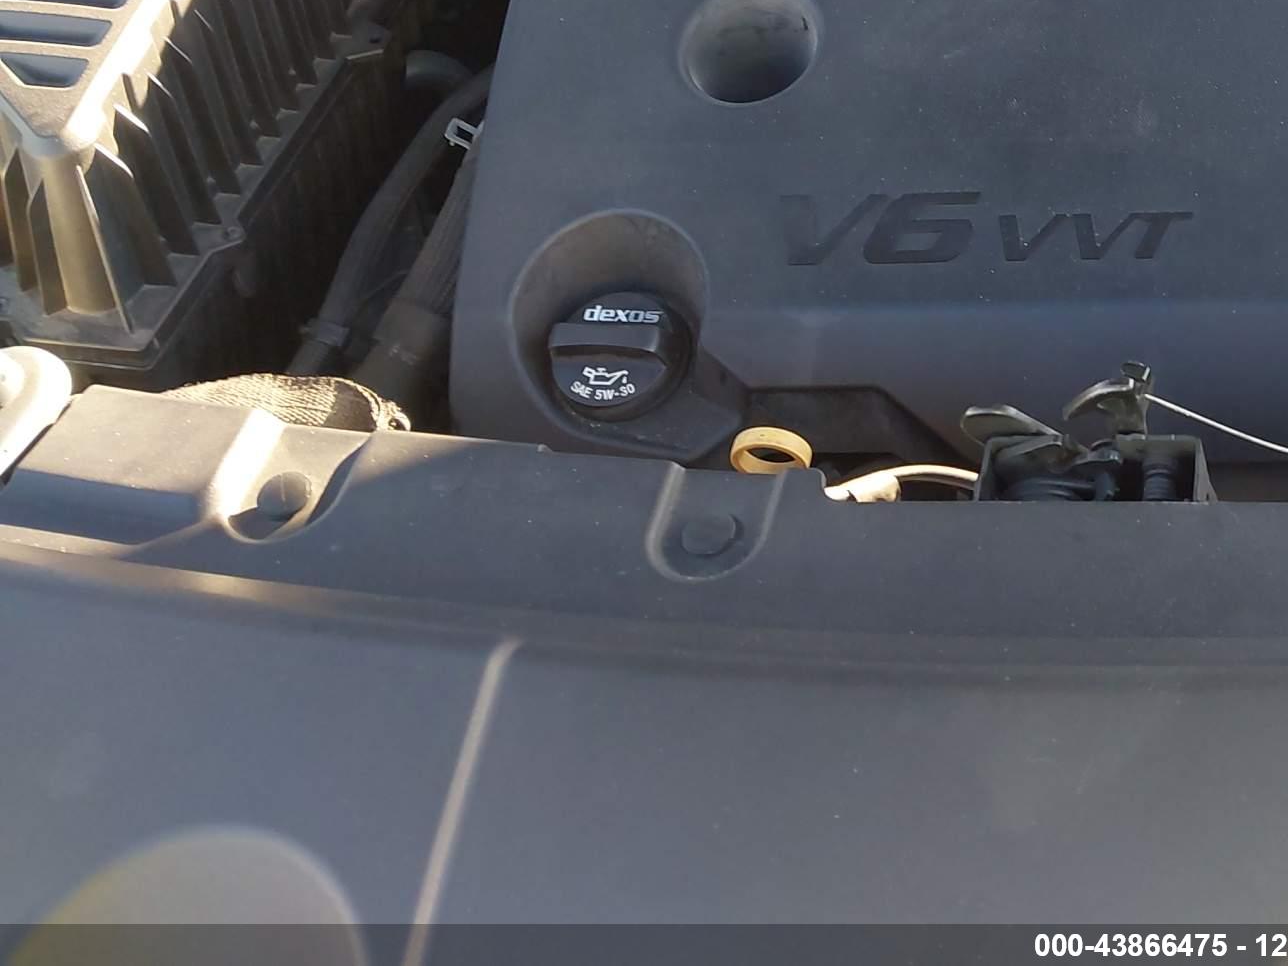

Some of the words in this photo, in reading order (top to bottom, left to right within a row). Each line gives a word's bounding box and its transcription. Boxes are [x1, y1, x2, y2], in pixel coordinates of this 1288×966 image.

[778, 190, 982, 266] V6
[998, 210, 1194, 263] VVT
[583, 305, 664, 324] dexos
[570, 381, 593, 399] SAE
